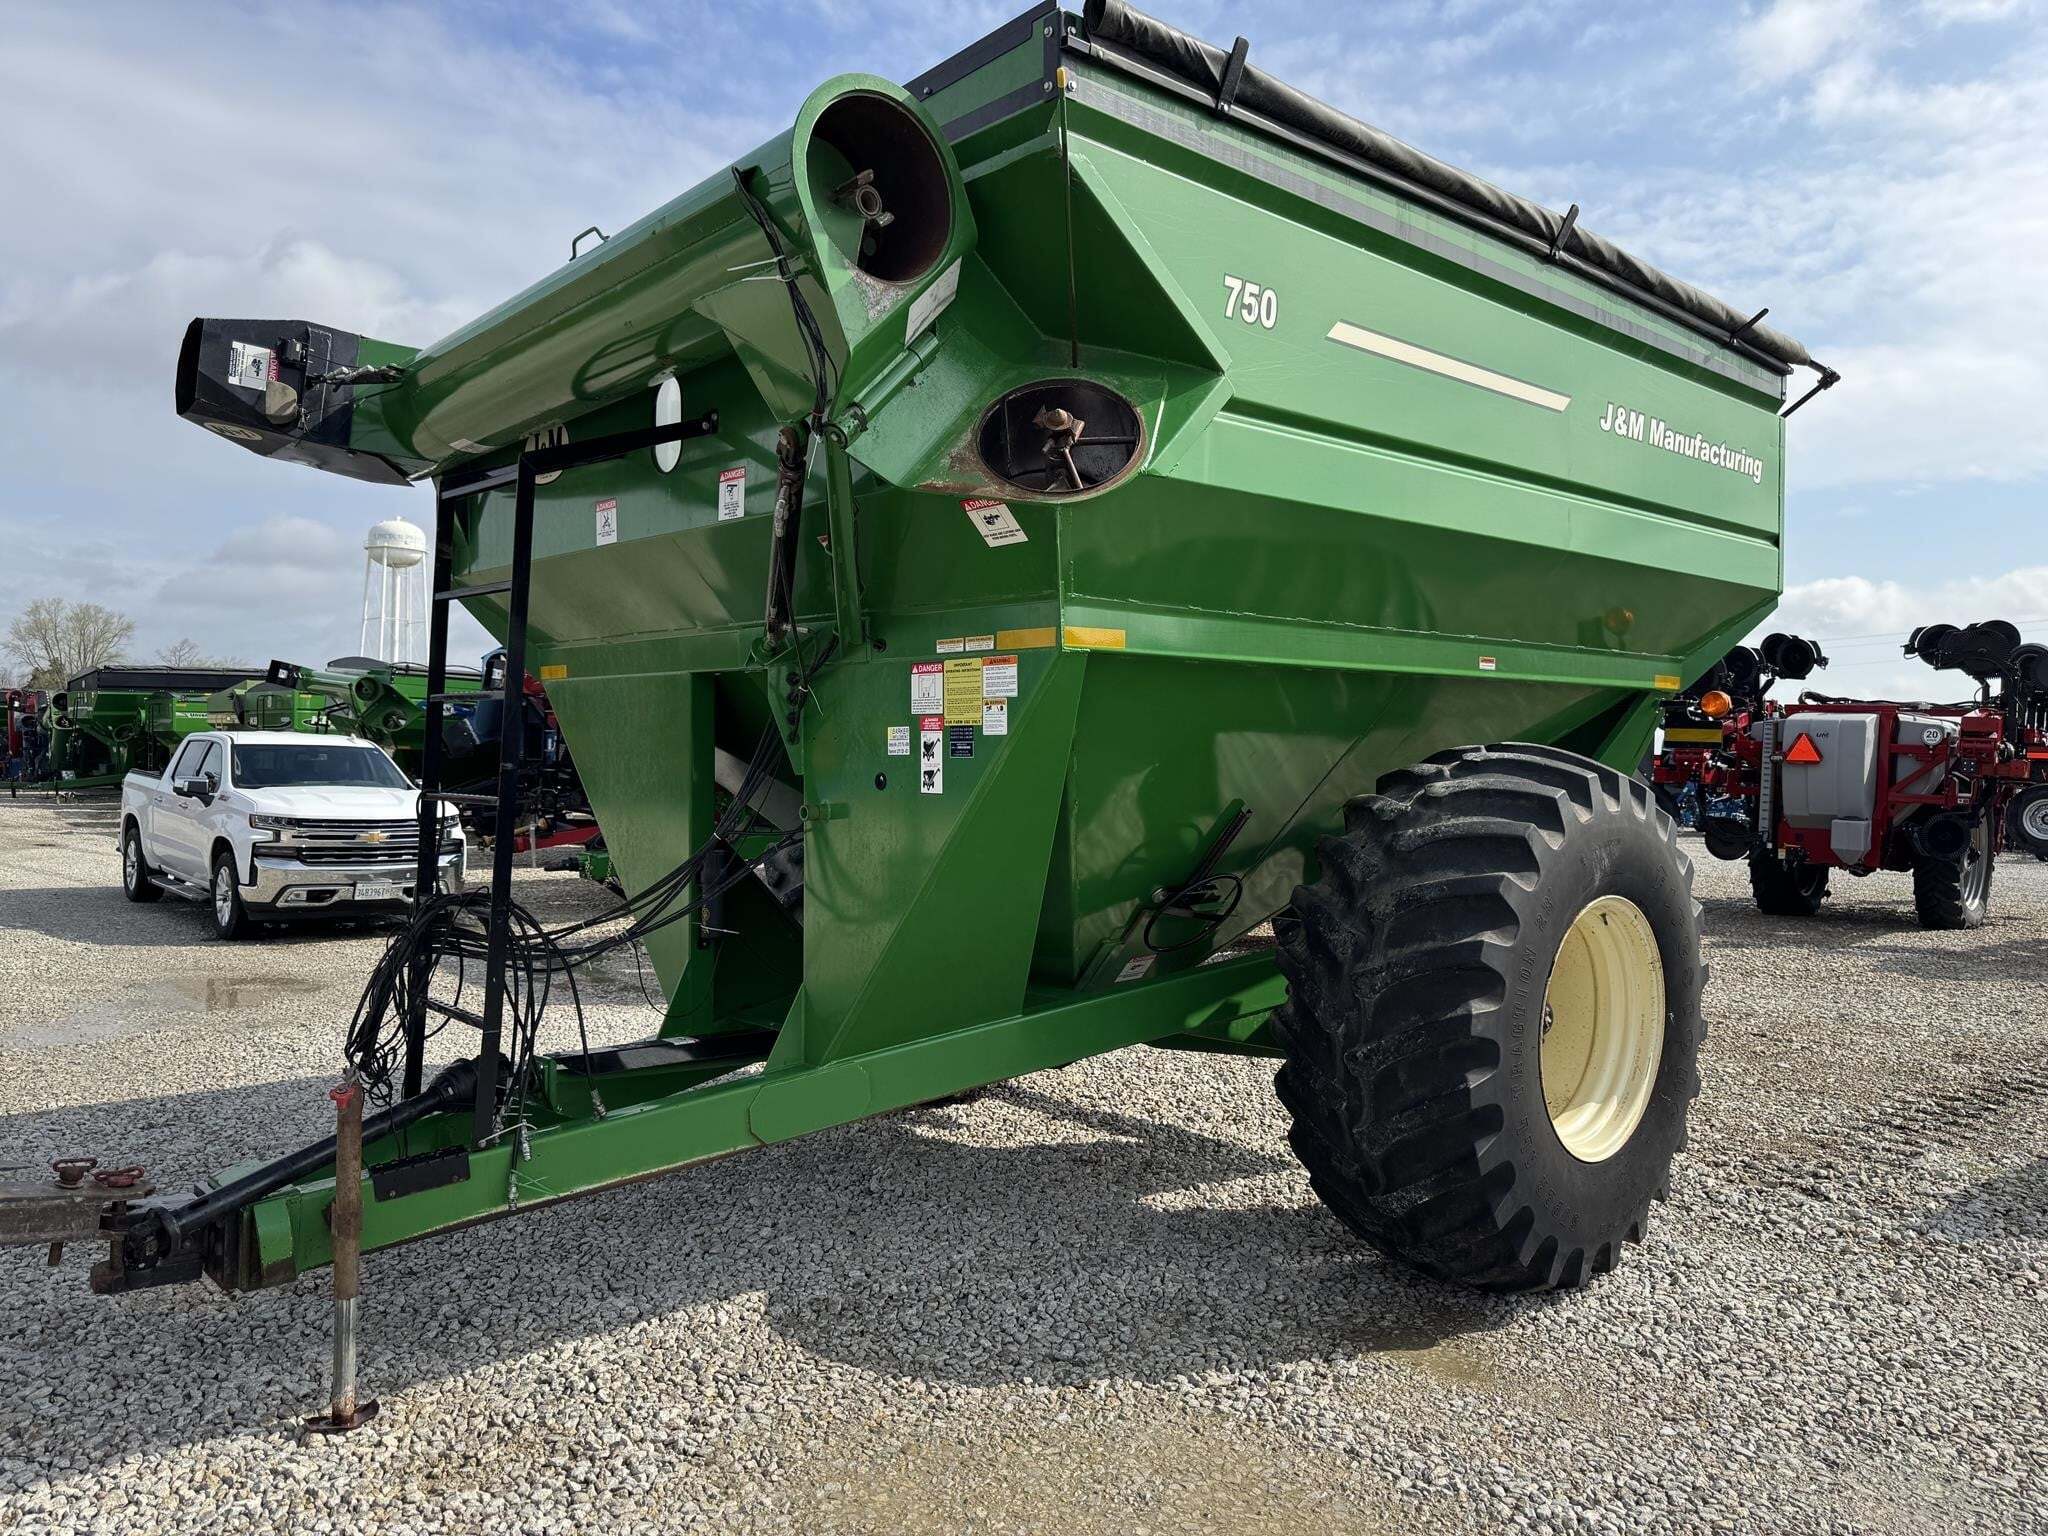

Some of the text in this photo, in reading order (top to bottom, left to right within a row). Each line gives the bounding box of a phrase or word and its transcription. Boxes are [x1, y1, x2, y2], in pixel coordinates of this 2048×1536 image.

[1223, 273, 1278, 330] 750
[1600, 401, 1763, 485] J&M Manufacturing
[918, 664, 943, 673] DANGER
[1925, 730, 1939, 738] 20
